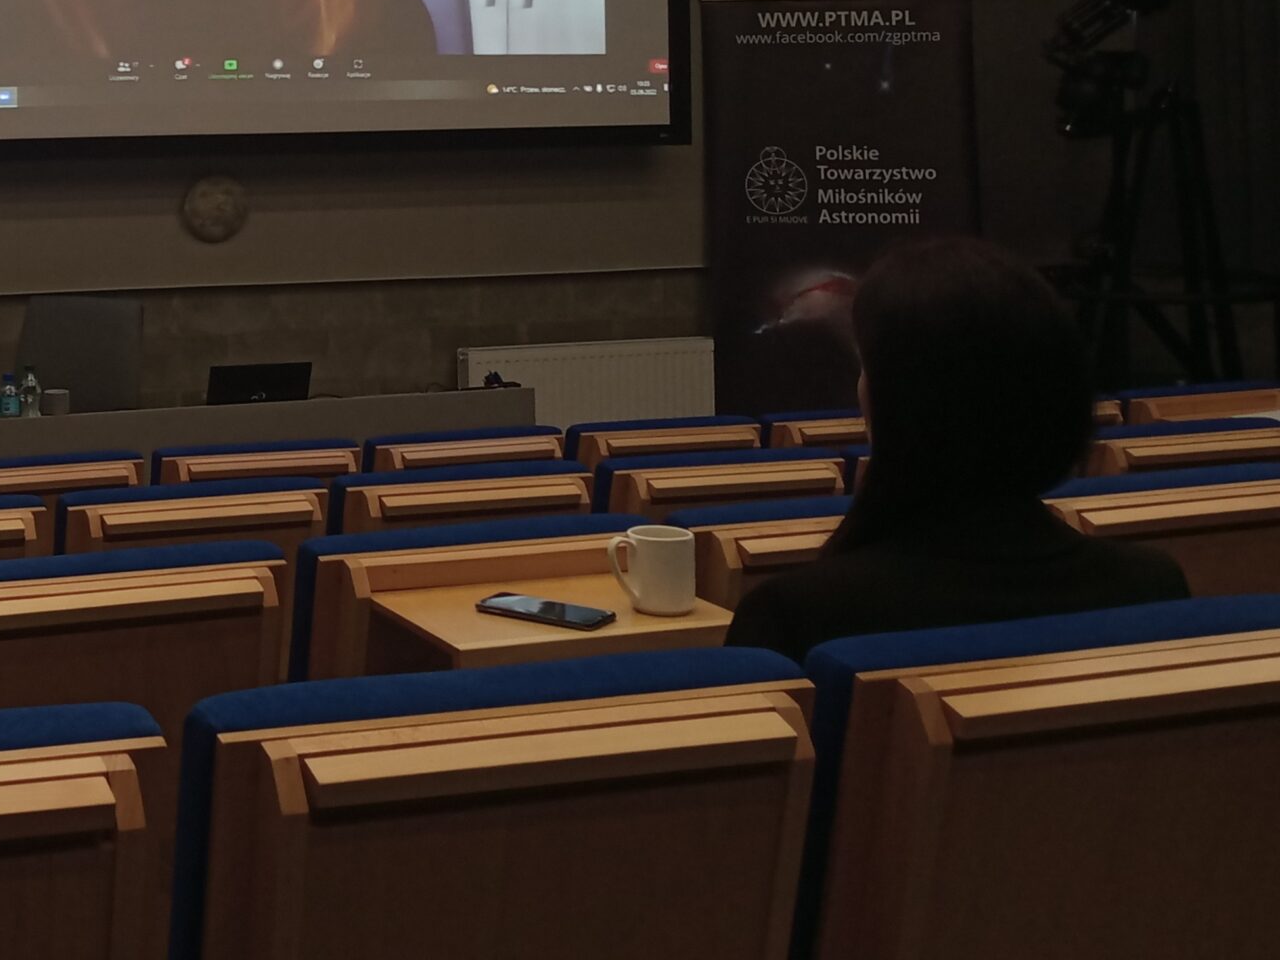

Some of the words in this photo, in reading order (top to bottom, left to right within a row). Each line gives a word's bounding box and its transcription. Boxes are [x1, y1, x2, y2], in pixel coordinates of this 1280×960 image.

[757, 9, 917, 29] WWW.PTMA.PL
[735, 30, 941, 46] www.facebook.com/zgptma
[814, 145, 881, 162] Polskie
[816, 164, 938, 185] Towarzystwo
[817, 187, 924, 205] Miłośników
[818, 208, 921, 225] Astronomii
